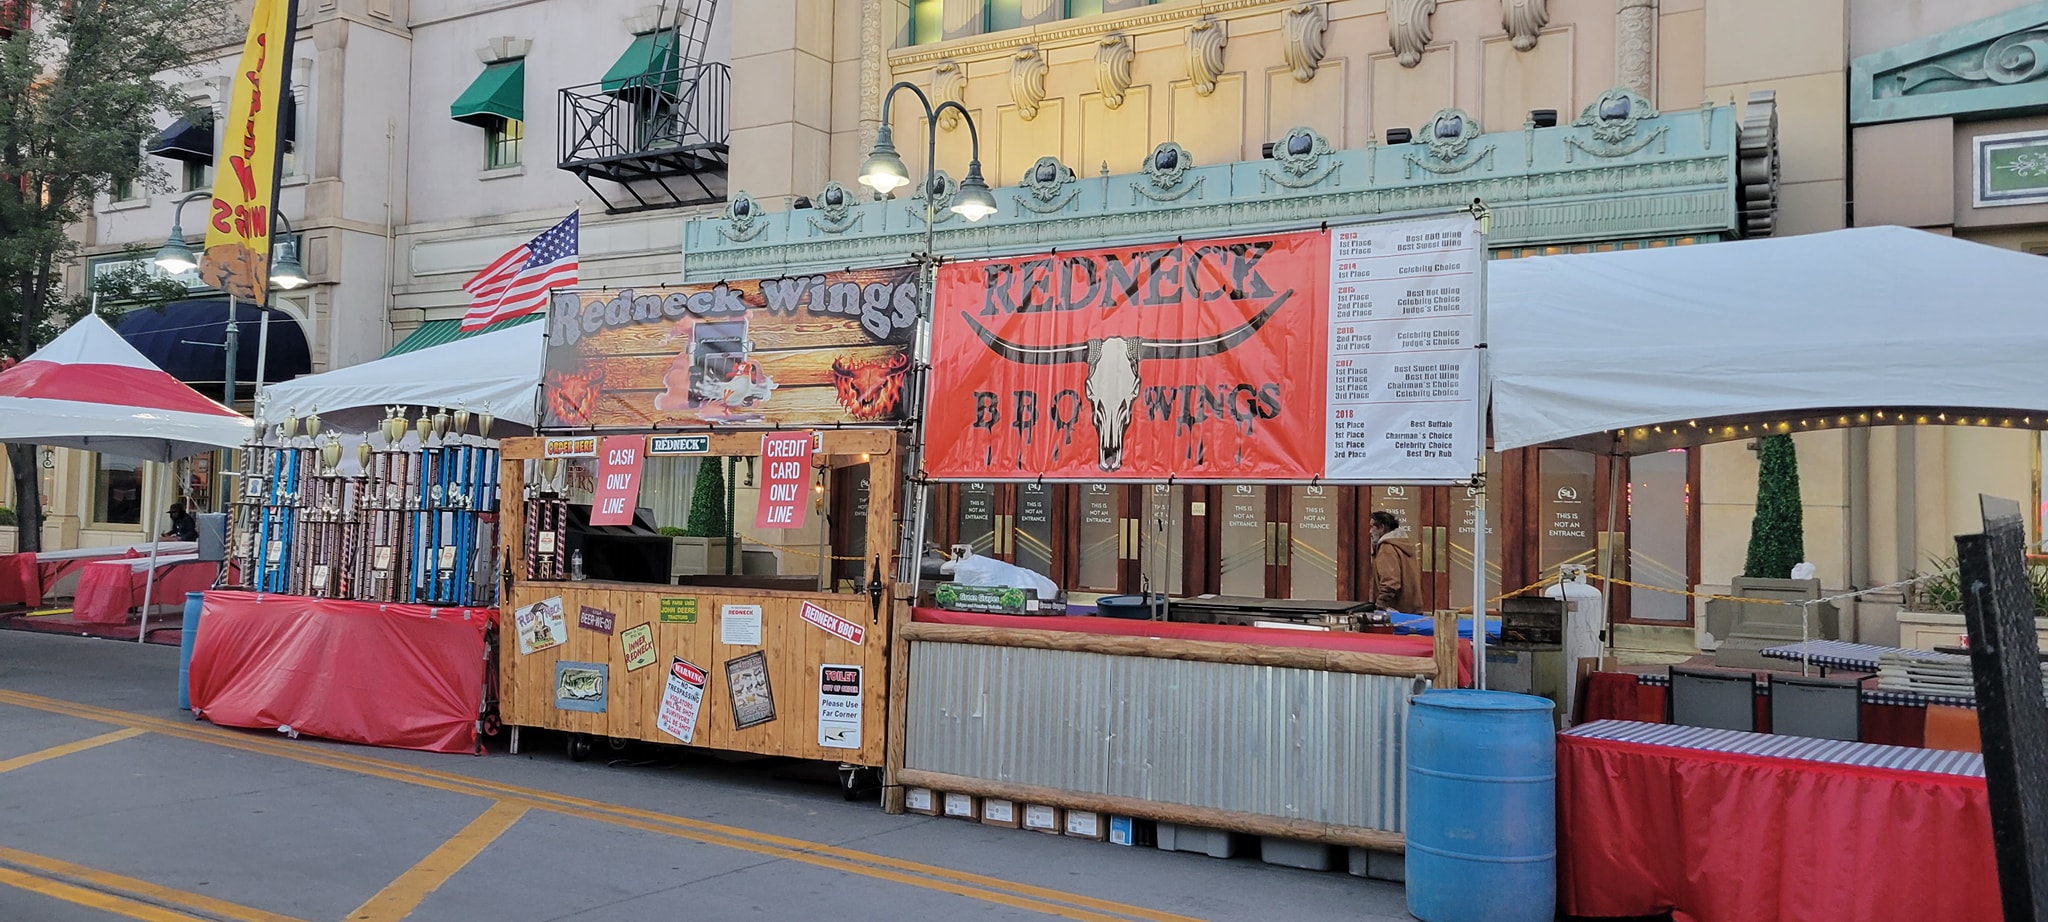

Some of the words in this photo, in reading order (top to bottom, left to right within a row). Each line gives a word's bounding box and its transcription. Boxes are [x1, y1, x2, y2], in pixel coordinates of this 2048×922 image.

[1340, 232, 1358, 240] 2013
[1399, 266, 1432, 274] Celebrity
[1434, 263, 1460, 271] Choice
[980, 242, 1278, 317] REDNECK
[1398, 298, 1432, 306] Celebrity
[1434, 296, 1460, 304] Choice
[1434, 304, 1460, 312] Choice
[549, 283, 745, 348] Redneck
[760, 274, 916, 340] Wings
[1398, 332, 1431, 340] Celebrity
[1433, 330, 1459, 338] Choice
[1433, 338, 1459, 346] Choice
[1439, 372, 1459, 380] Wing
[1143, 383, 1281, 430] WINGS
[1336, 410, 1353, 418] 2018
[548, 440, 572, 454] ORDER
[574, 439, 593, 453] HERE
[655, 439, 700, 450] REDNECK
[768, 439, 808, 457] CREDIT
[609, 449, 634, 465] CASH
[770, 462, 800, 479] CARD
[606, 474, 631, 490] ONLY
[770, 484, 798, 501] ONLY
[602, 498, 625, 514] LINE
[768, 506, 794, 522] LINE
[960, 593, 977, 601] Green
[979, 593, 1000, 603] Grapes
[517, 612, 534, 627] RED
[544, 604, 561, 618] NECK
[804, 606, 838, 631] REDNECK
[838, 621, 854, 640] BBQ
[629, 635, 645, 652] INNER
[626, 641, 652, 663] REDNECK
[675, 664, 702, 683] WARNING
[825, 670, 857, 682] TOILET
[668, 683, 700, 703] TRESPASSING
[665, 700, 675, 709] WILL
[683, 708, 694, 718] SHOT
[670, 694, 693, 709] VIOLATORS
[822, 699, 843, 707] Please
[662, 714, 671, 723] WILL
[679, 723, 691, 732] SHOT
[666, 708, 690, 724] SURVIVORS
[668, 725, 681, 735] AGAIN
